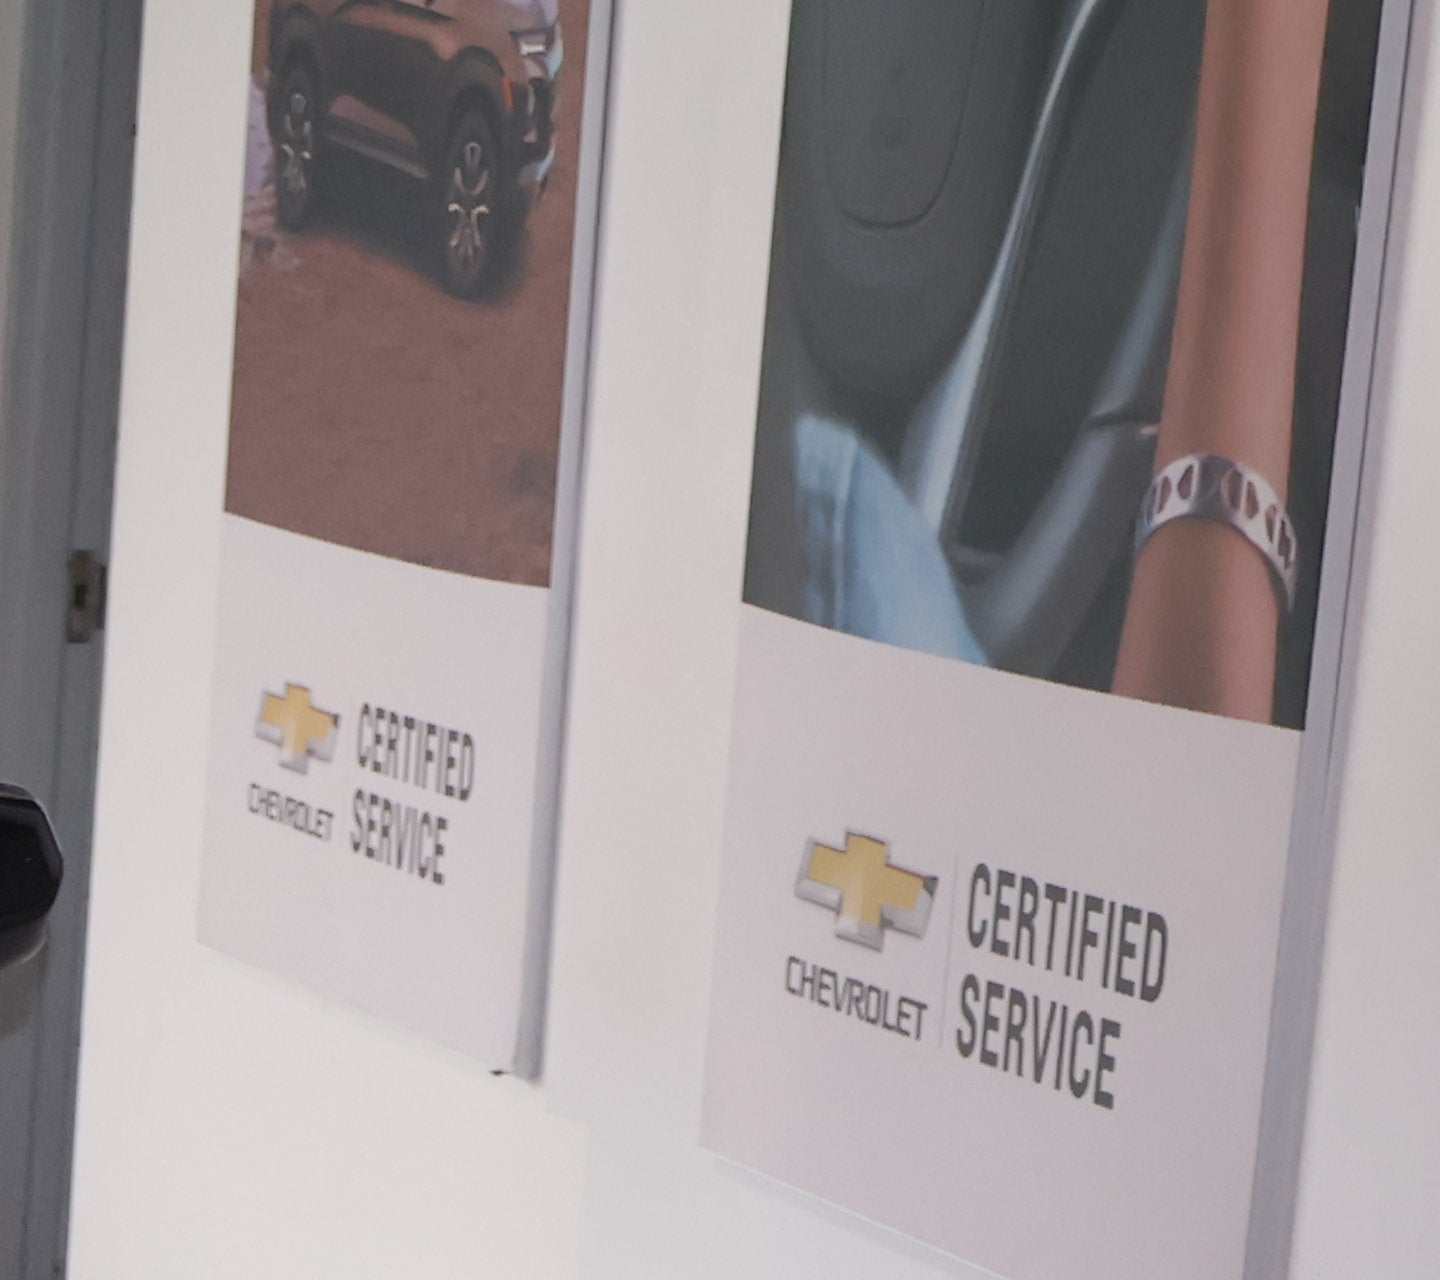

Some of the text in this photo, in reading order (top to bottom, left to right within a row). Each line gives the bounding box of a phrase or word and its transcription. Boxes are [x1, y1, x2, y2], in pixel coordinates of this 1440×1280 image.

[357, 702, 475, 800] CERTIFIED
[247, 782, 334, 841] CHEVROLET
[350, 786, 448, 885] SERVICE
[966, 862, 1169, 1003] CERTIFIED
[785, 955, 928, 1041] CHEVROLET
[956, 973, 1122, 1110] SERVICE
